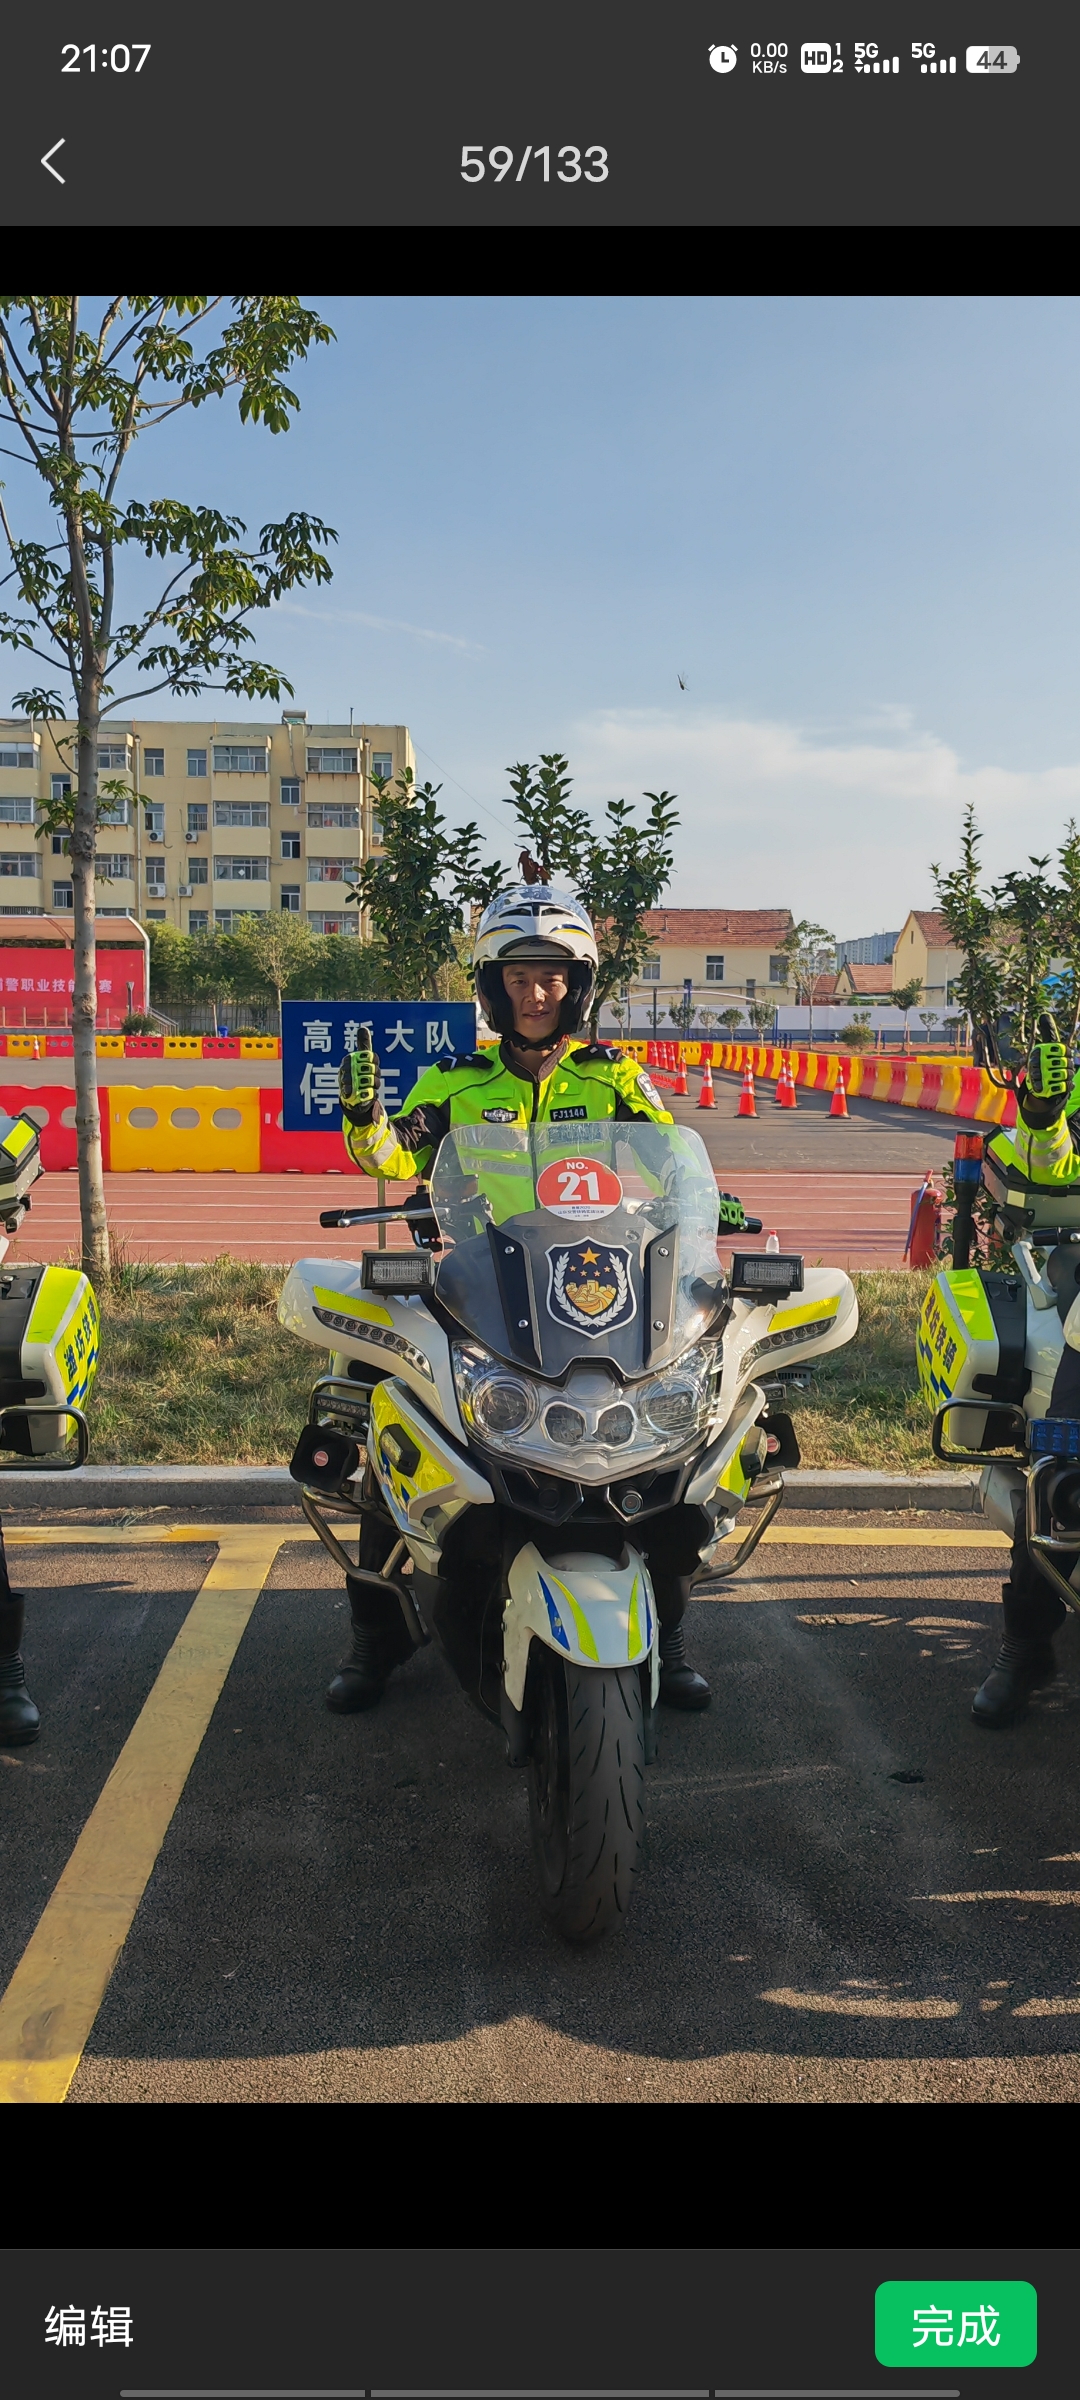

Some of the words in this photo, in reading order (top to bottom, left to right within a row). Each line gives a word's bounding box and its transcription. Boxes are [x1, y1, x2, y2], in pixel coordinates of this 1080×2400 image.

[302, 1019, 456, 1054] 高新大队
[552, 1107, 585, 1120] FJ1144
[566, 1161, 589, 1170] NO.
[557, 1171, 600, 1202] 21
